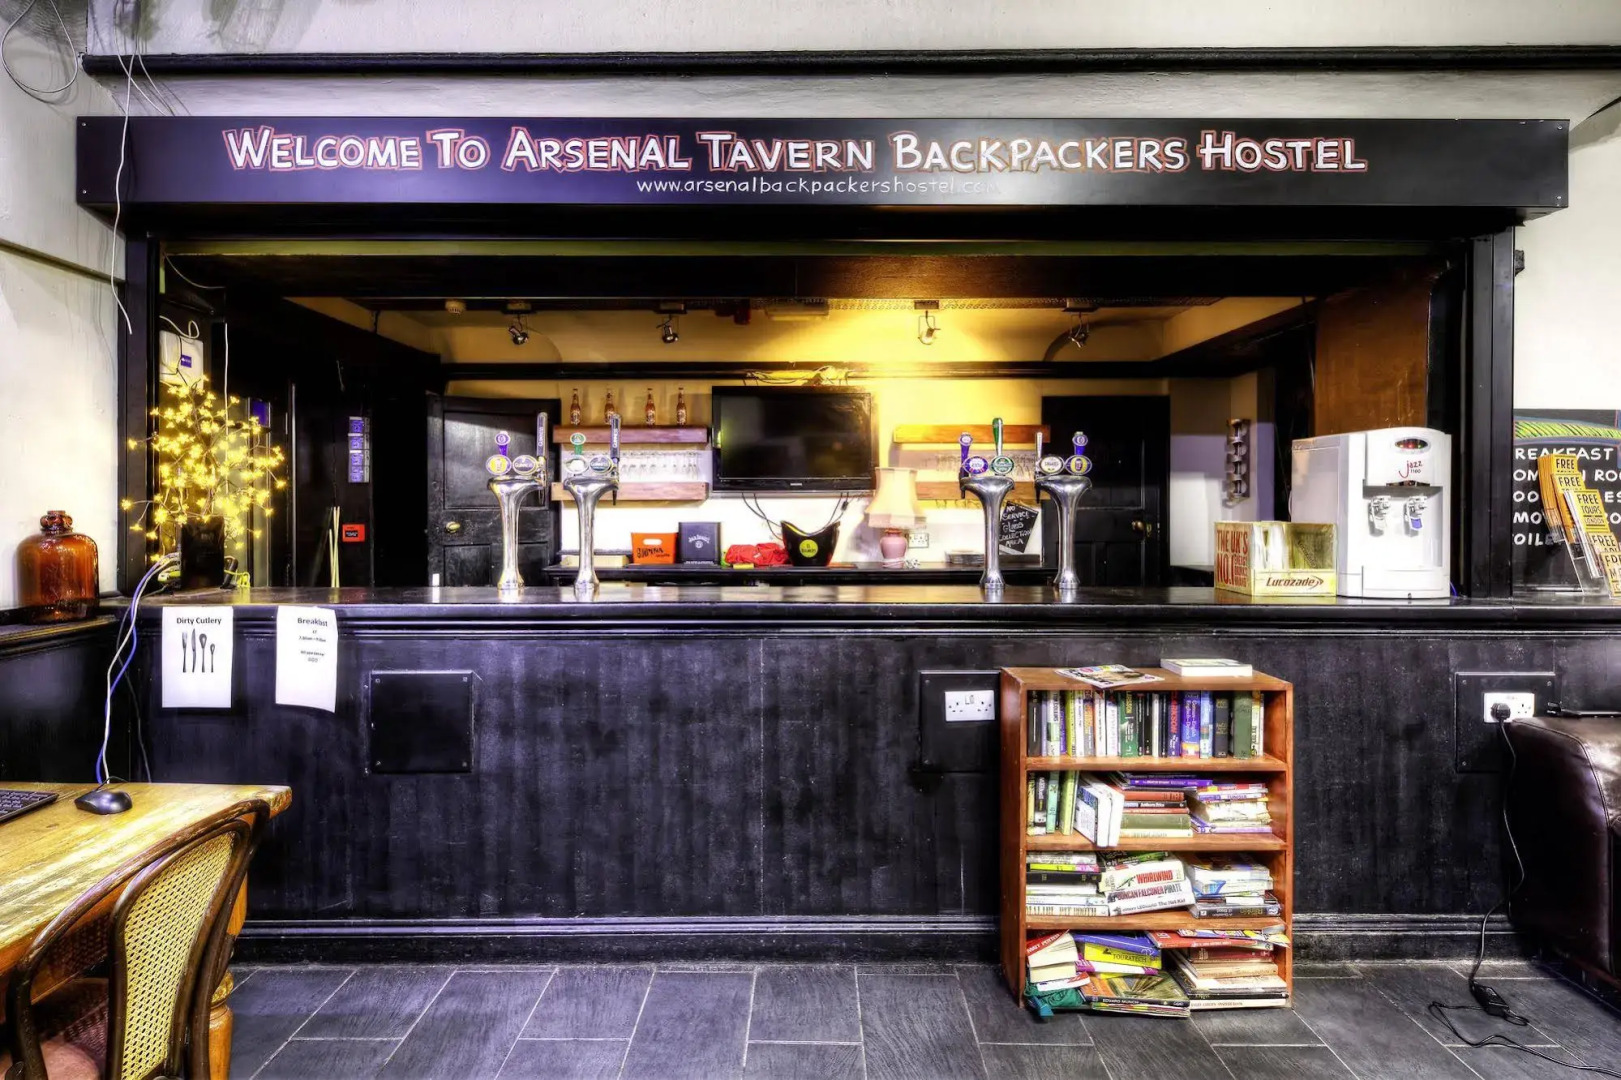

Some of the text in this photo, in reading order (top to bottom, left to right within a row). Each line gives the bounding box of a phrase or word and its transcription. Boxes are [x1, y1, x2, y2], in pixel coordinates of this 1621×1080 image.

[222, 126, 1368, 173] WELCOME TO ARSENAL TAVERN BACKPACKERS HOSTEL
[1556, 459, 1575, 469] FREE
[1558, 476, 1582, 487] FREE
[1577, 494, 1599, 504] FREE
[1581, 505, 1602, 514] TOURS
[1216, 530, 1248, 554] THE UK'S
[1592, 535, 1616, 547] FREE
[1266, 577, 1316, 588] Lucozade
[176, 617, 222, 625] Dirty Cutlery
[1136, 869, 1173, 884] WHIRLWIND
[1164, 878, 1183, 894] PIRATE
[1113, 953, 1148, 963] TOURATECH
